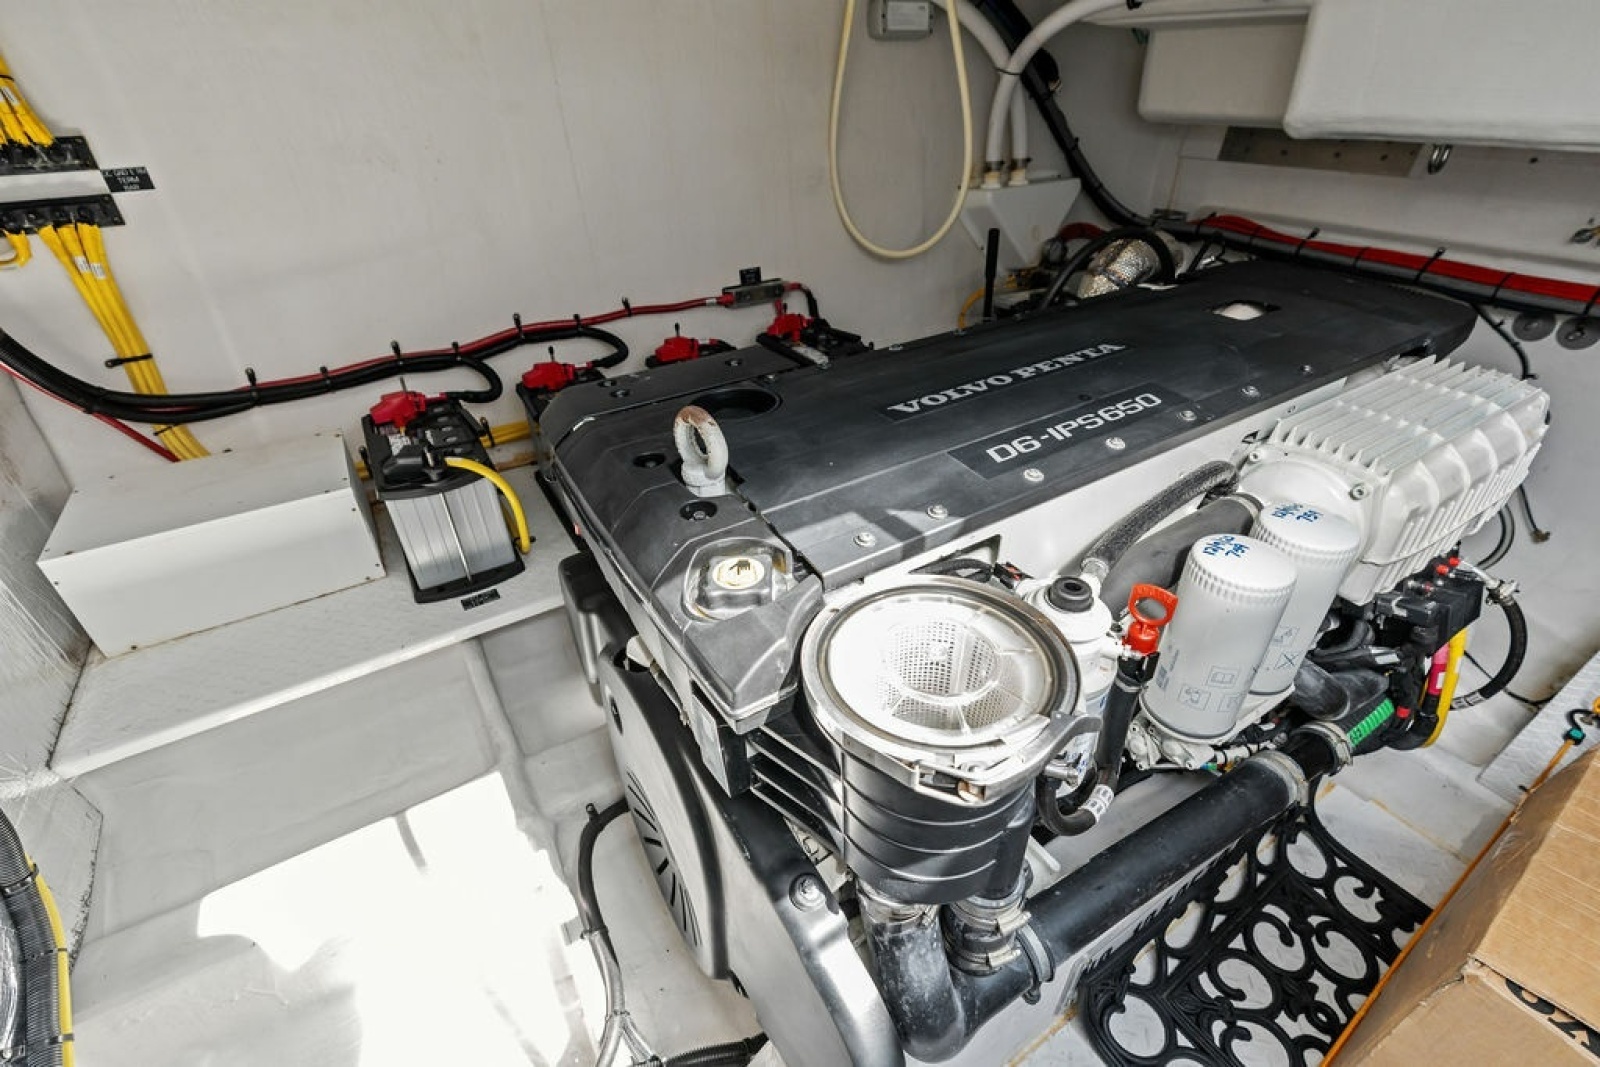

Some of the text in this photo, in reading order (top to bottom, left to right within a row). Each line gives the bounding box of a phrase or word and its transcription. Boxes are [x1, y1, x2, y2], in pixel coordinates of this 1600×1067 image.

[887, 342, 1126, 414] VOLVO PENTA
[985, 392, 1163, 464] D6-IPS650
